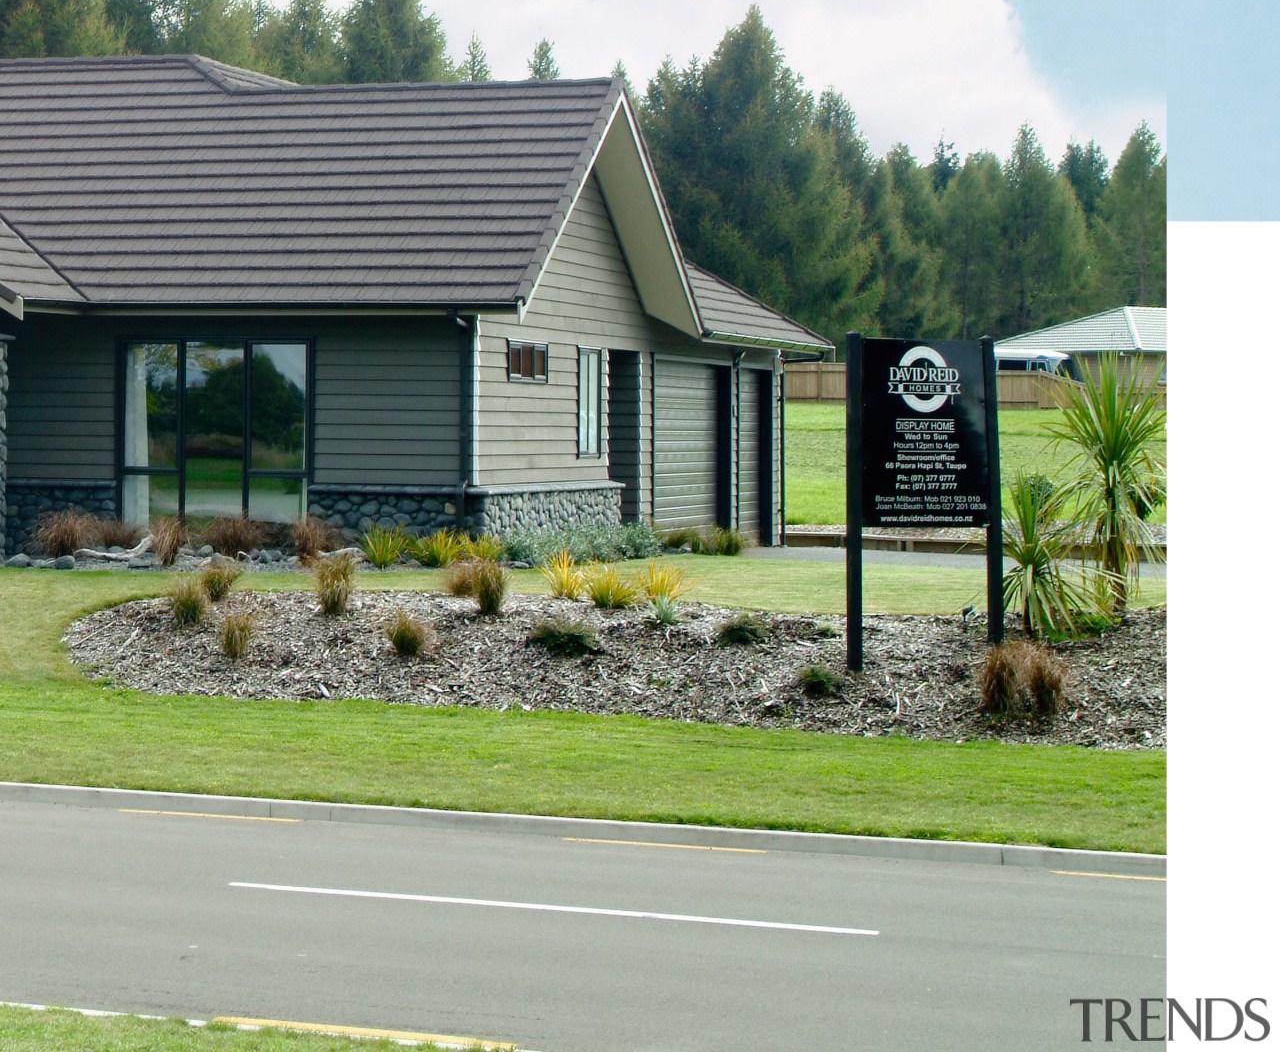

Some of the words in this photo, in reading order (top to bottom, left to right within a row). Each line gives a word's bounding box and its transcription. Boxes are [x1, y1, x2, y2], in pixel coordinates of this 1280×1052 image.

[889, 366, 927, 381] DAVID
[928, 368, 959, 382] REID
[909, 384, 941, 392] HOMES
[895, 421, 929, 430] DISPLAY
[930, 421, 955, 431] HOME
[916, 442, 934, 450] 12pm
[944, 442, 960, 450] 4pm
[946, 462, 967, 470] Taupo
[910, 474, 924, 482] (07)
[912, 483, 926, 491] (07)
[880, 514, 973, 522] www.davidreidhomes.co.nz
